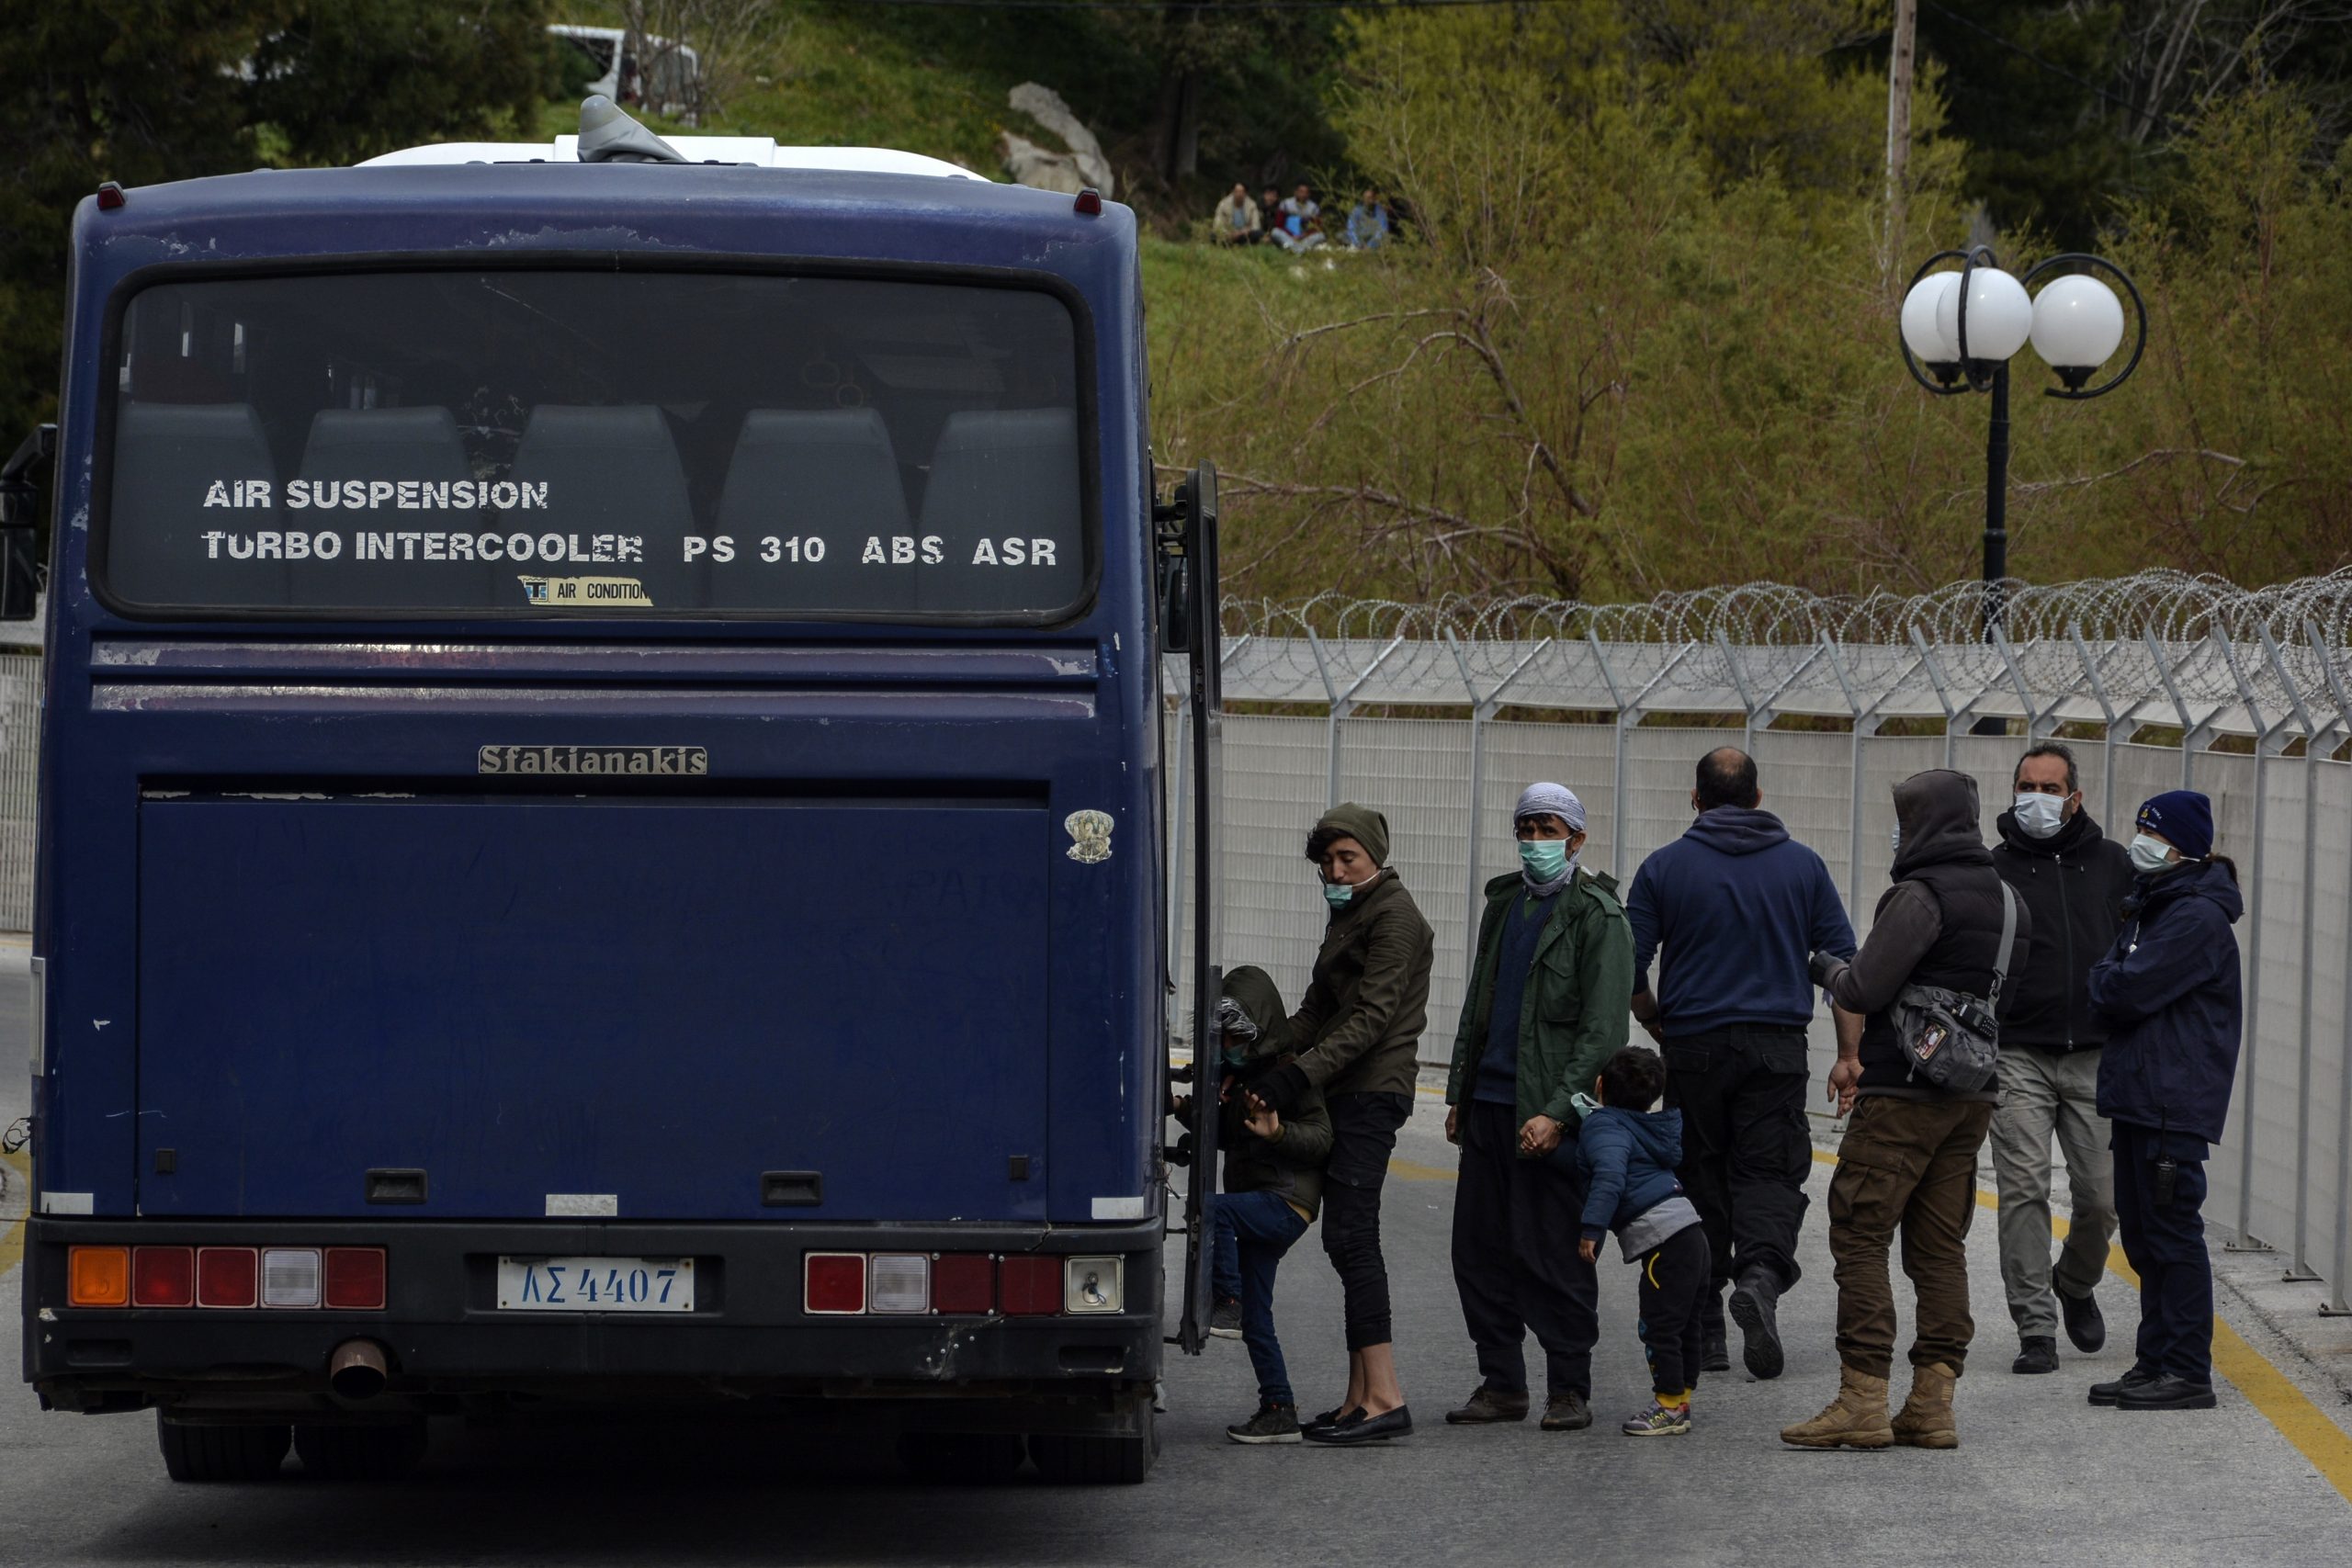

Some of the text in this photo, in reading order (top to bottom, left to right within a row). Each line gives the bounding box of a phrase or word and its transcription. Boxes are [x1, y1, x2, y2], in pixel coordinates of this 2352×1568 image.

[202, 479, 548, 510] AIR SUSPENSION
[200, 531, 1057, 566] TURBO INTERCOOLER PS 310 ABS ASR
[557, 582, 577, 599] AIR
[480, 745, 707, 774] Sfakianakis
